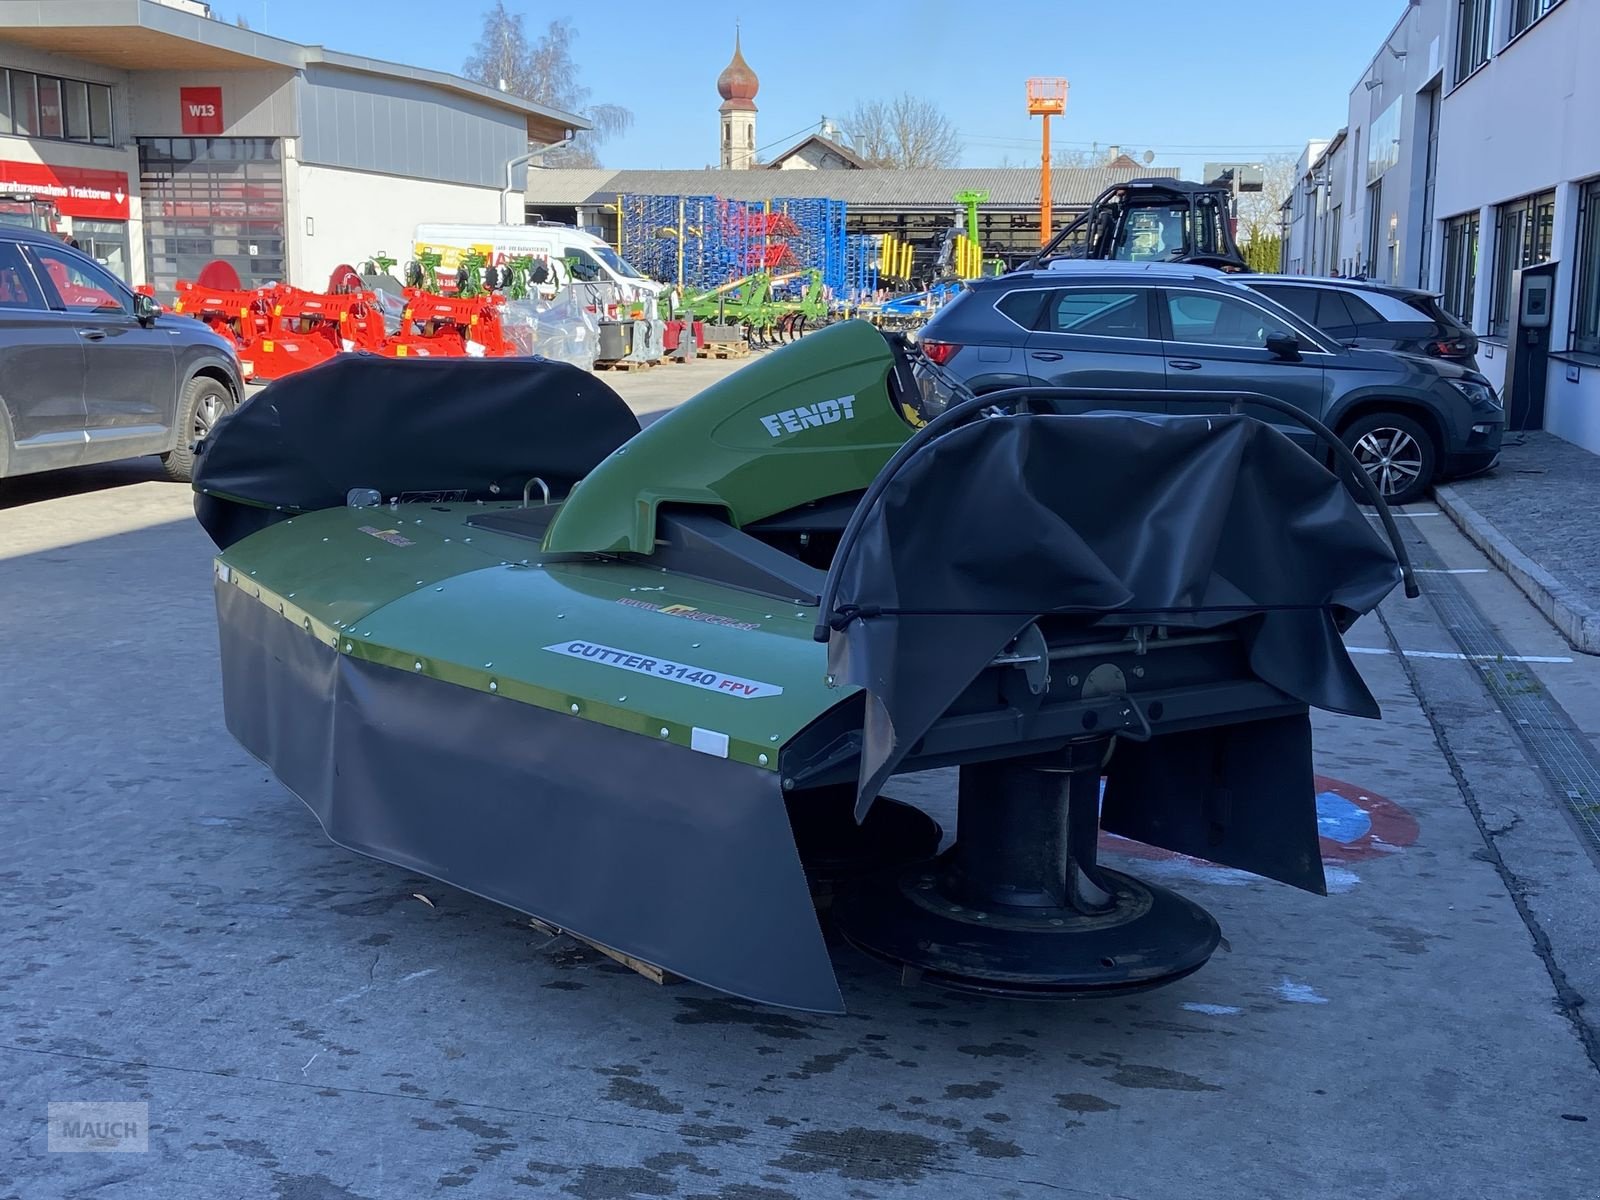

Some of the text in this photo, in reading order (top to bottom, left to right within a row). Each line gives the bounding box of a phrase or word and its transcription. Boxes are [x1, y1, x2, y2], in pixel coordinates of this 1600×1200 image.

[189, 105, 215, 117] W13
[69, 186, 111, 200] Traktoren
[478, 252, 548, 267] MAH
[760, 395, 856, 437] FENDT
[567, 643, 760, 696] CUTTER 3140 FPV
